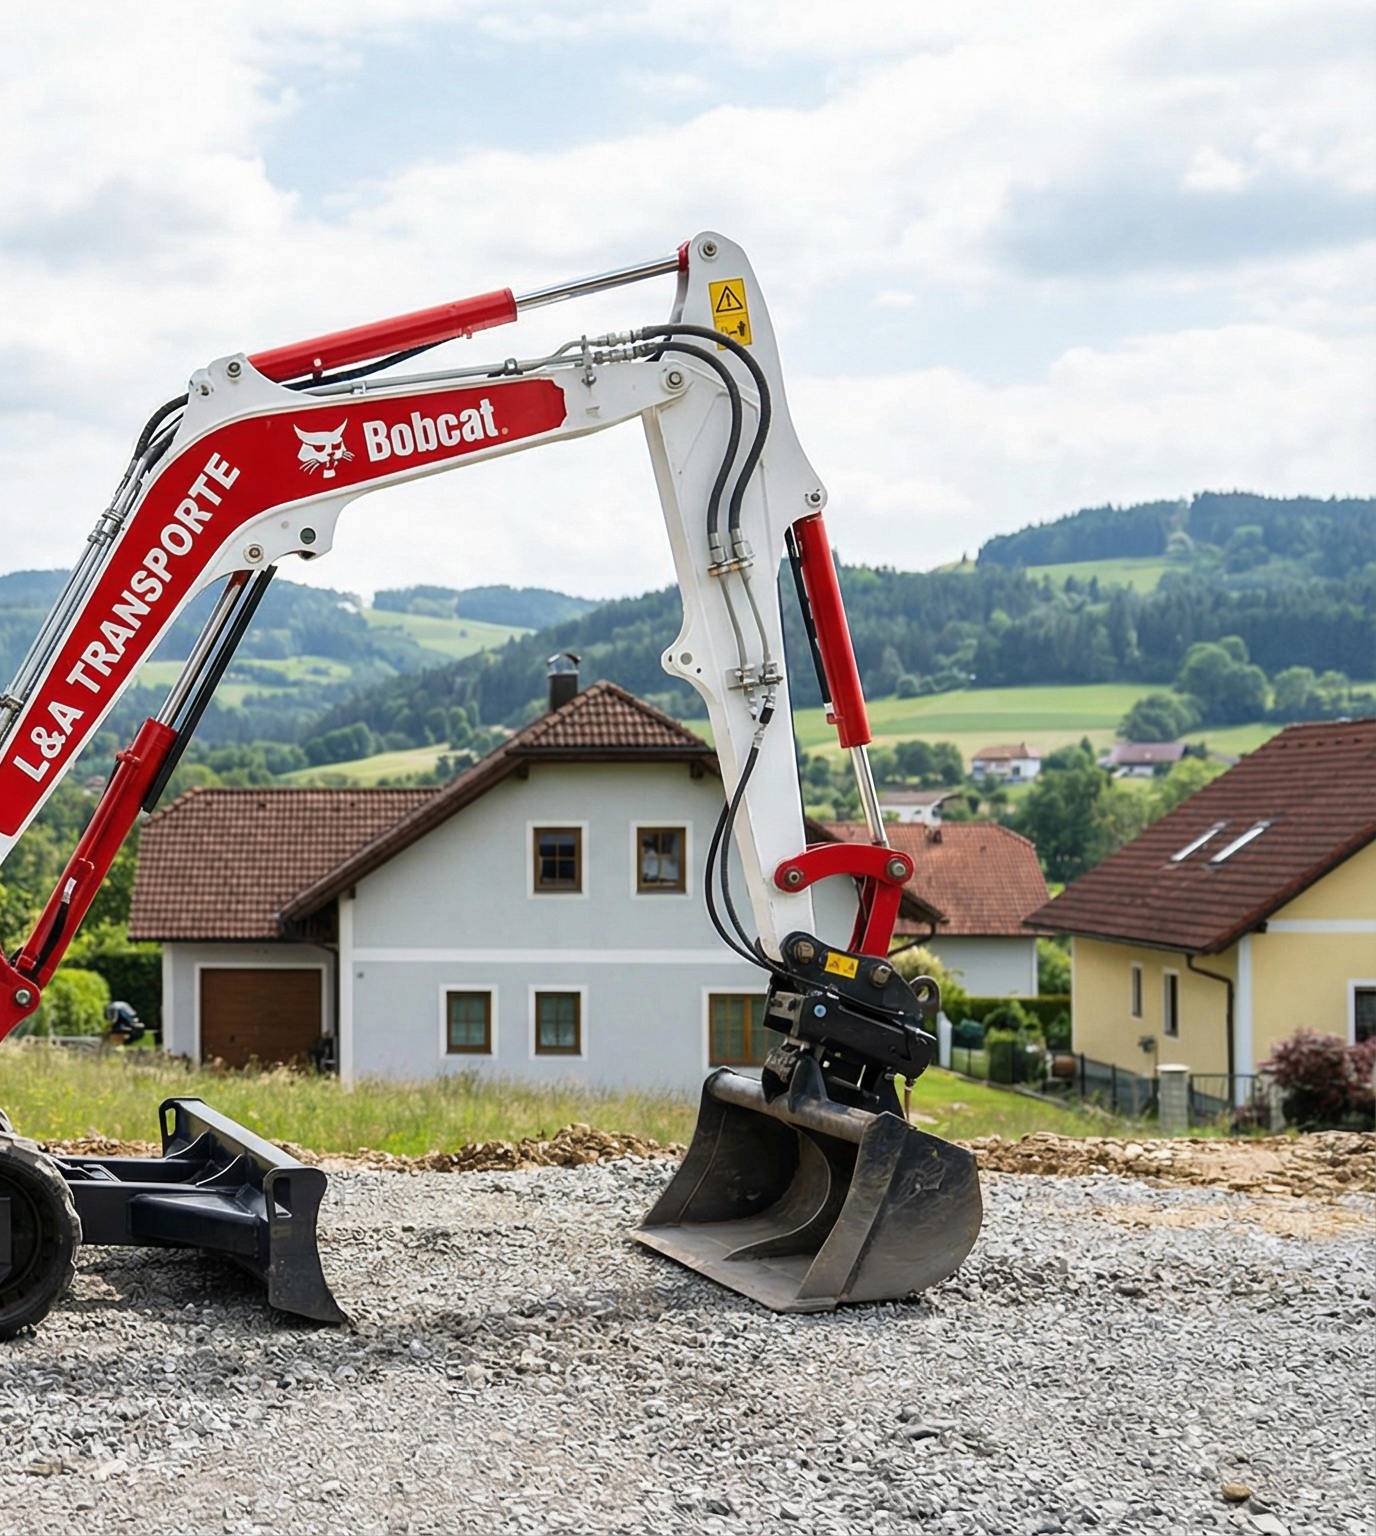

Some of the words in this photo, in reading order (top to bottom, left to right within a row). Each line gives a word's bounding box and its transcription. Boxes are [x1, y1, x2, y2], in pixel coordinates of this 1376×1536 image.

[362, 398, 499, 463] Bobcat
[12, 700, 85, 783] L&A
[65, 452, 241, 694] TRANSPORTE
